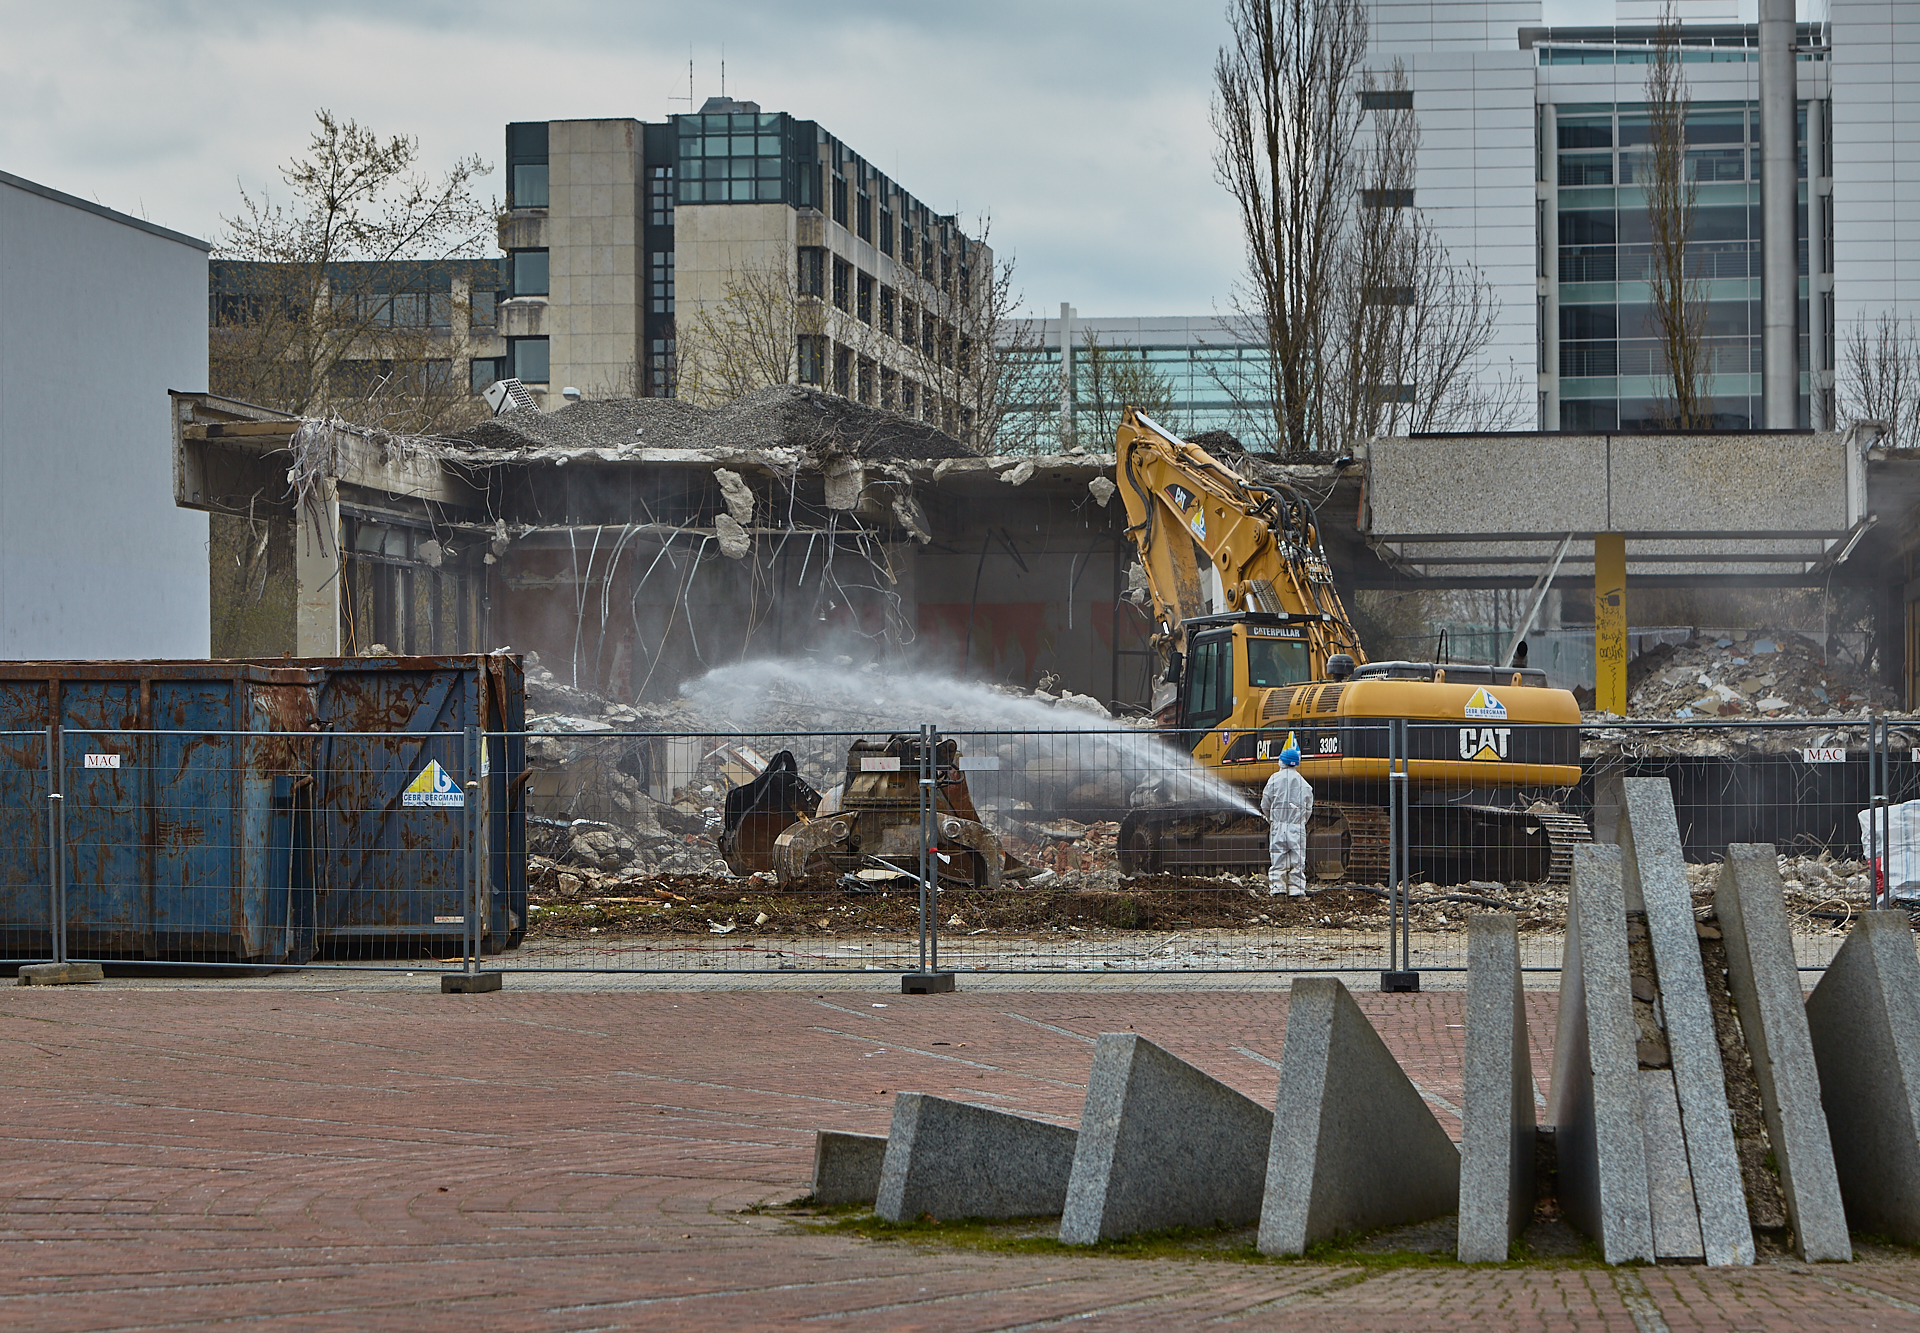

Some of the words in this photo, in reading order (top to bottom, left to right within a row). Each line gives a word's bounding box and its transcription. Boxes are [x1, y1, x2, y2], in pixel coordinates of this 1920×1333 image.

[1253, 627, 1300, 638] CATERPILLAR
[1319, 737, 1338, 754] 330C
[1459, 728, 1511, 759] CAT
[1257, 740, 1272, 760] CAT
[1808, 749, 1843, 761] MAC
[88, 755, 117, 767] MAC
[862, 758, 898, 771] MAC
[425, 794, 464, 802] BERGMANN
